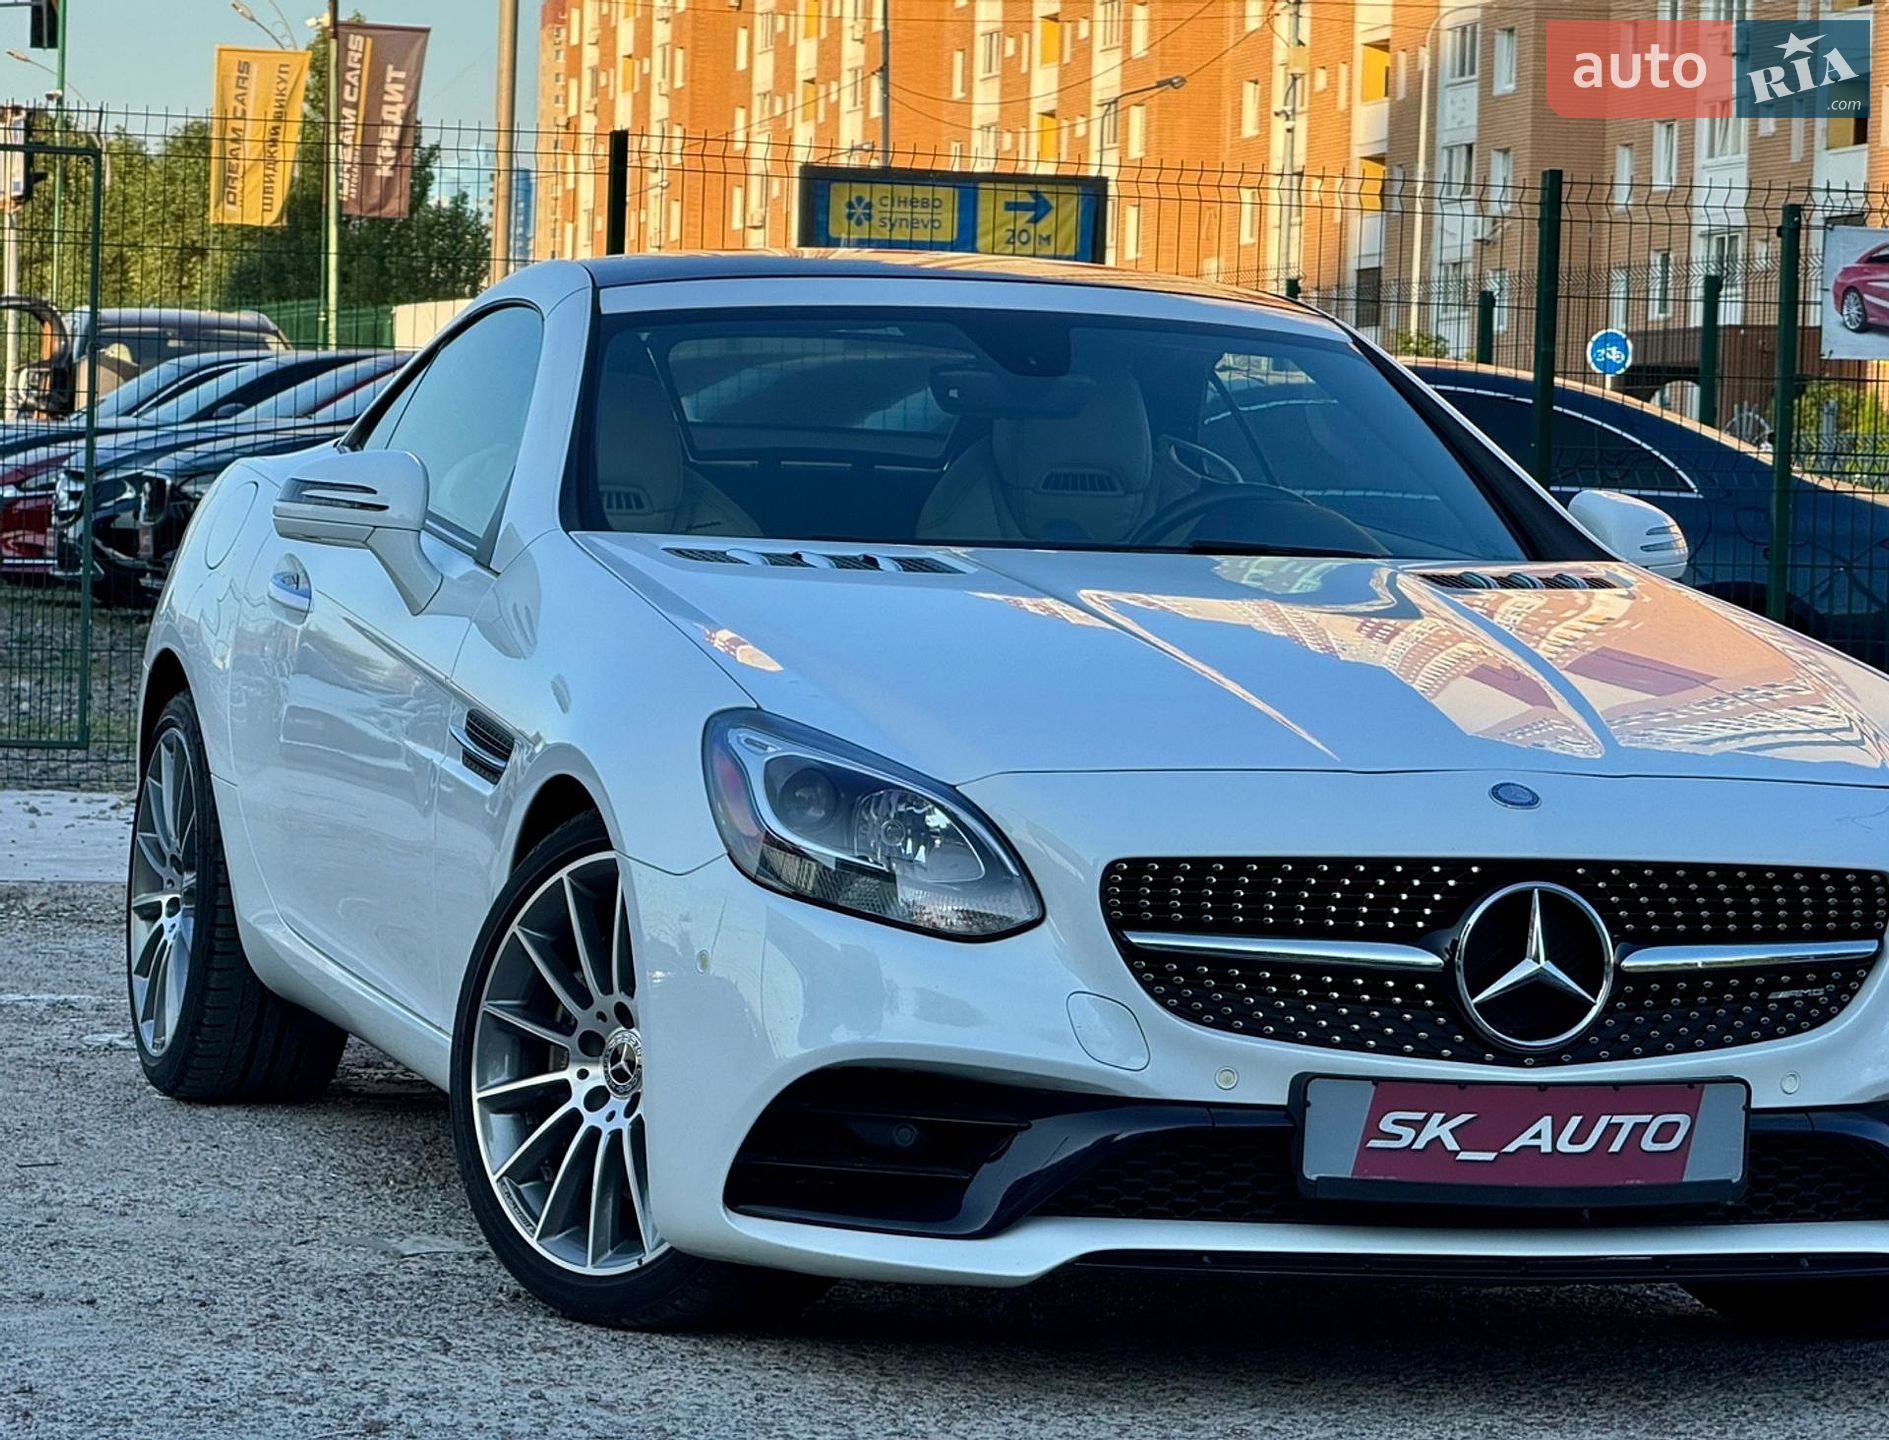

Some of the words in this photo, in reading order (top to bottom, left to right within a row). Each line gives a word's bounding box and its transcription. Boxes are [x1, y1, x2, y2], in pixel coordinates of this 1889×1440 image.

[232, 60, 250, 121] CARS
[272, 63, 291, 121] ВИКУП
[343, 34, 365, 103] CARS
[375, 64, 407, 176] КРЕДИТ
[226, 126, 244, 206] DREAM
[879, 216, 942, 232] synevo
[1005, 228, 1031, 245] 20
[1365, 1111, 1692, 1162] SK_AUTO
